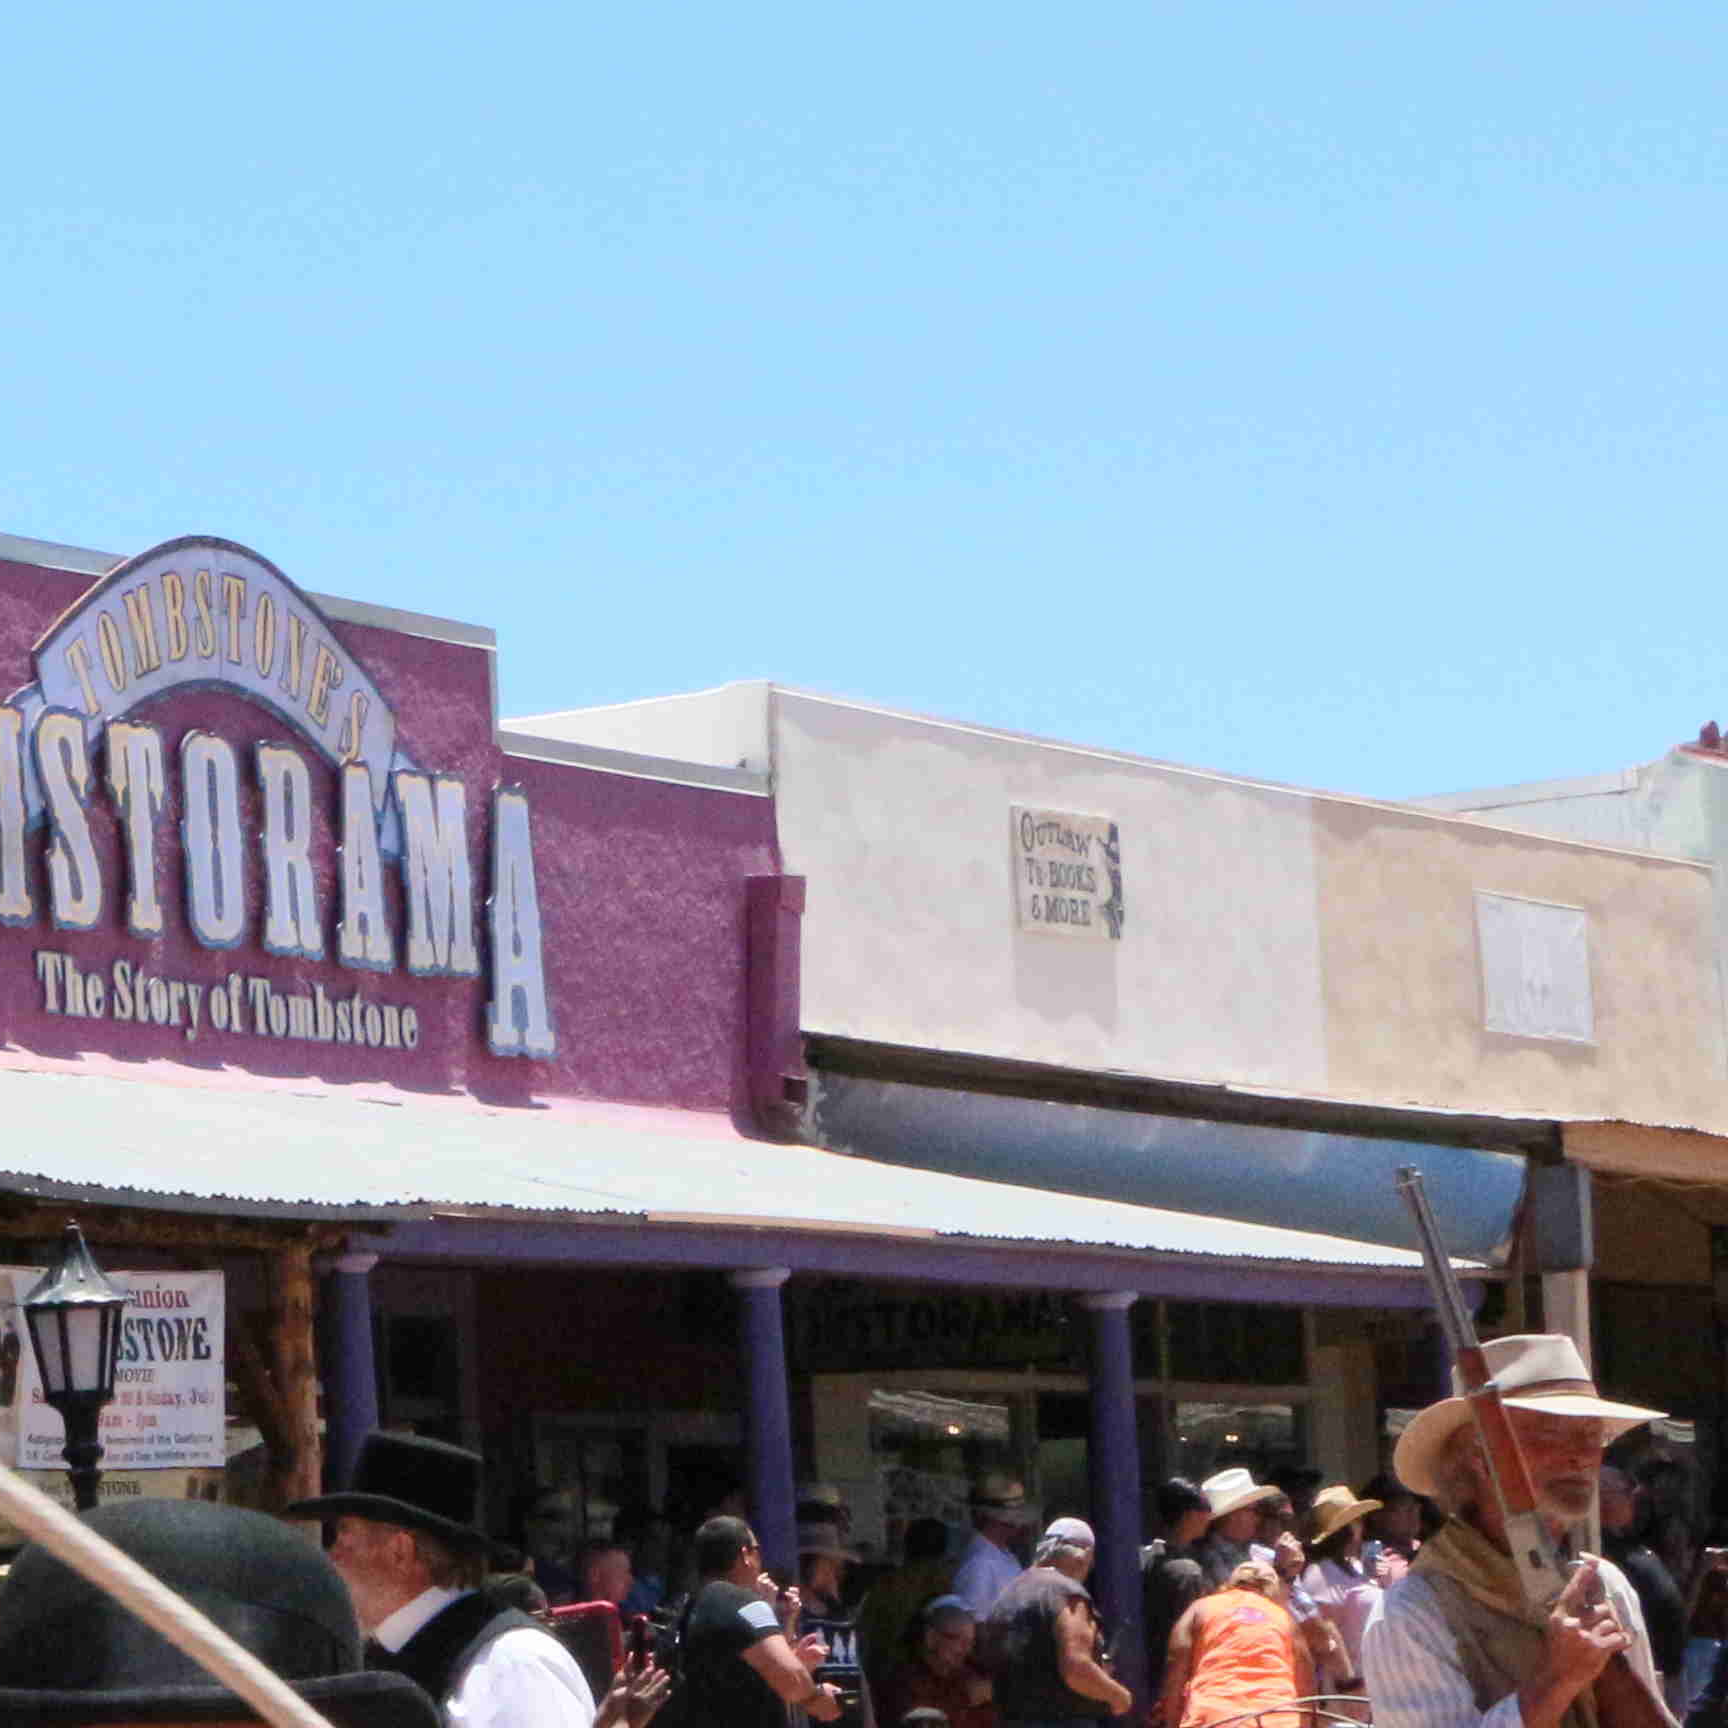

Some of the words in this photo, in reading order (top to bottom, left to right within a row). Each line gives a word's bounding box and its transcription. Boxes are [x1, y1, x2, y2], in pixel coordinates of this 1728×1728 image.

[65, 568, 371, 766] TOMBSTONE'S
[1048, 860, 1097, 894] BOOKS
[1044, 895, 1092, 926] MORE
[36, 950, 105, 1018] The
[112, 959, 203, 1041] Story
[209, 972, 244, 1034] of
[247, 976, 420, 1049] Tombstone
[118, 1316, 212, 1362] STONE
